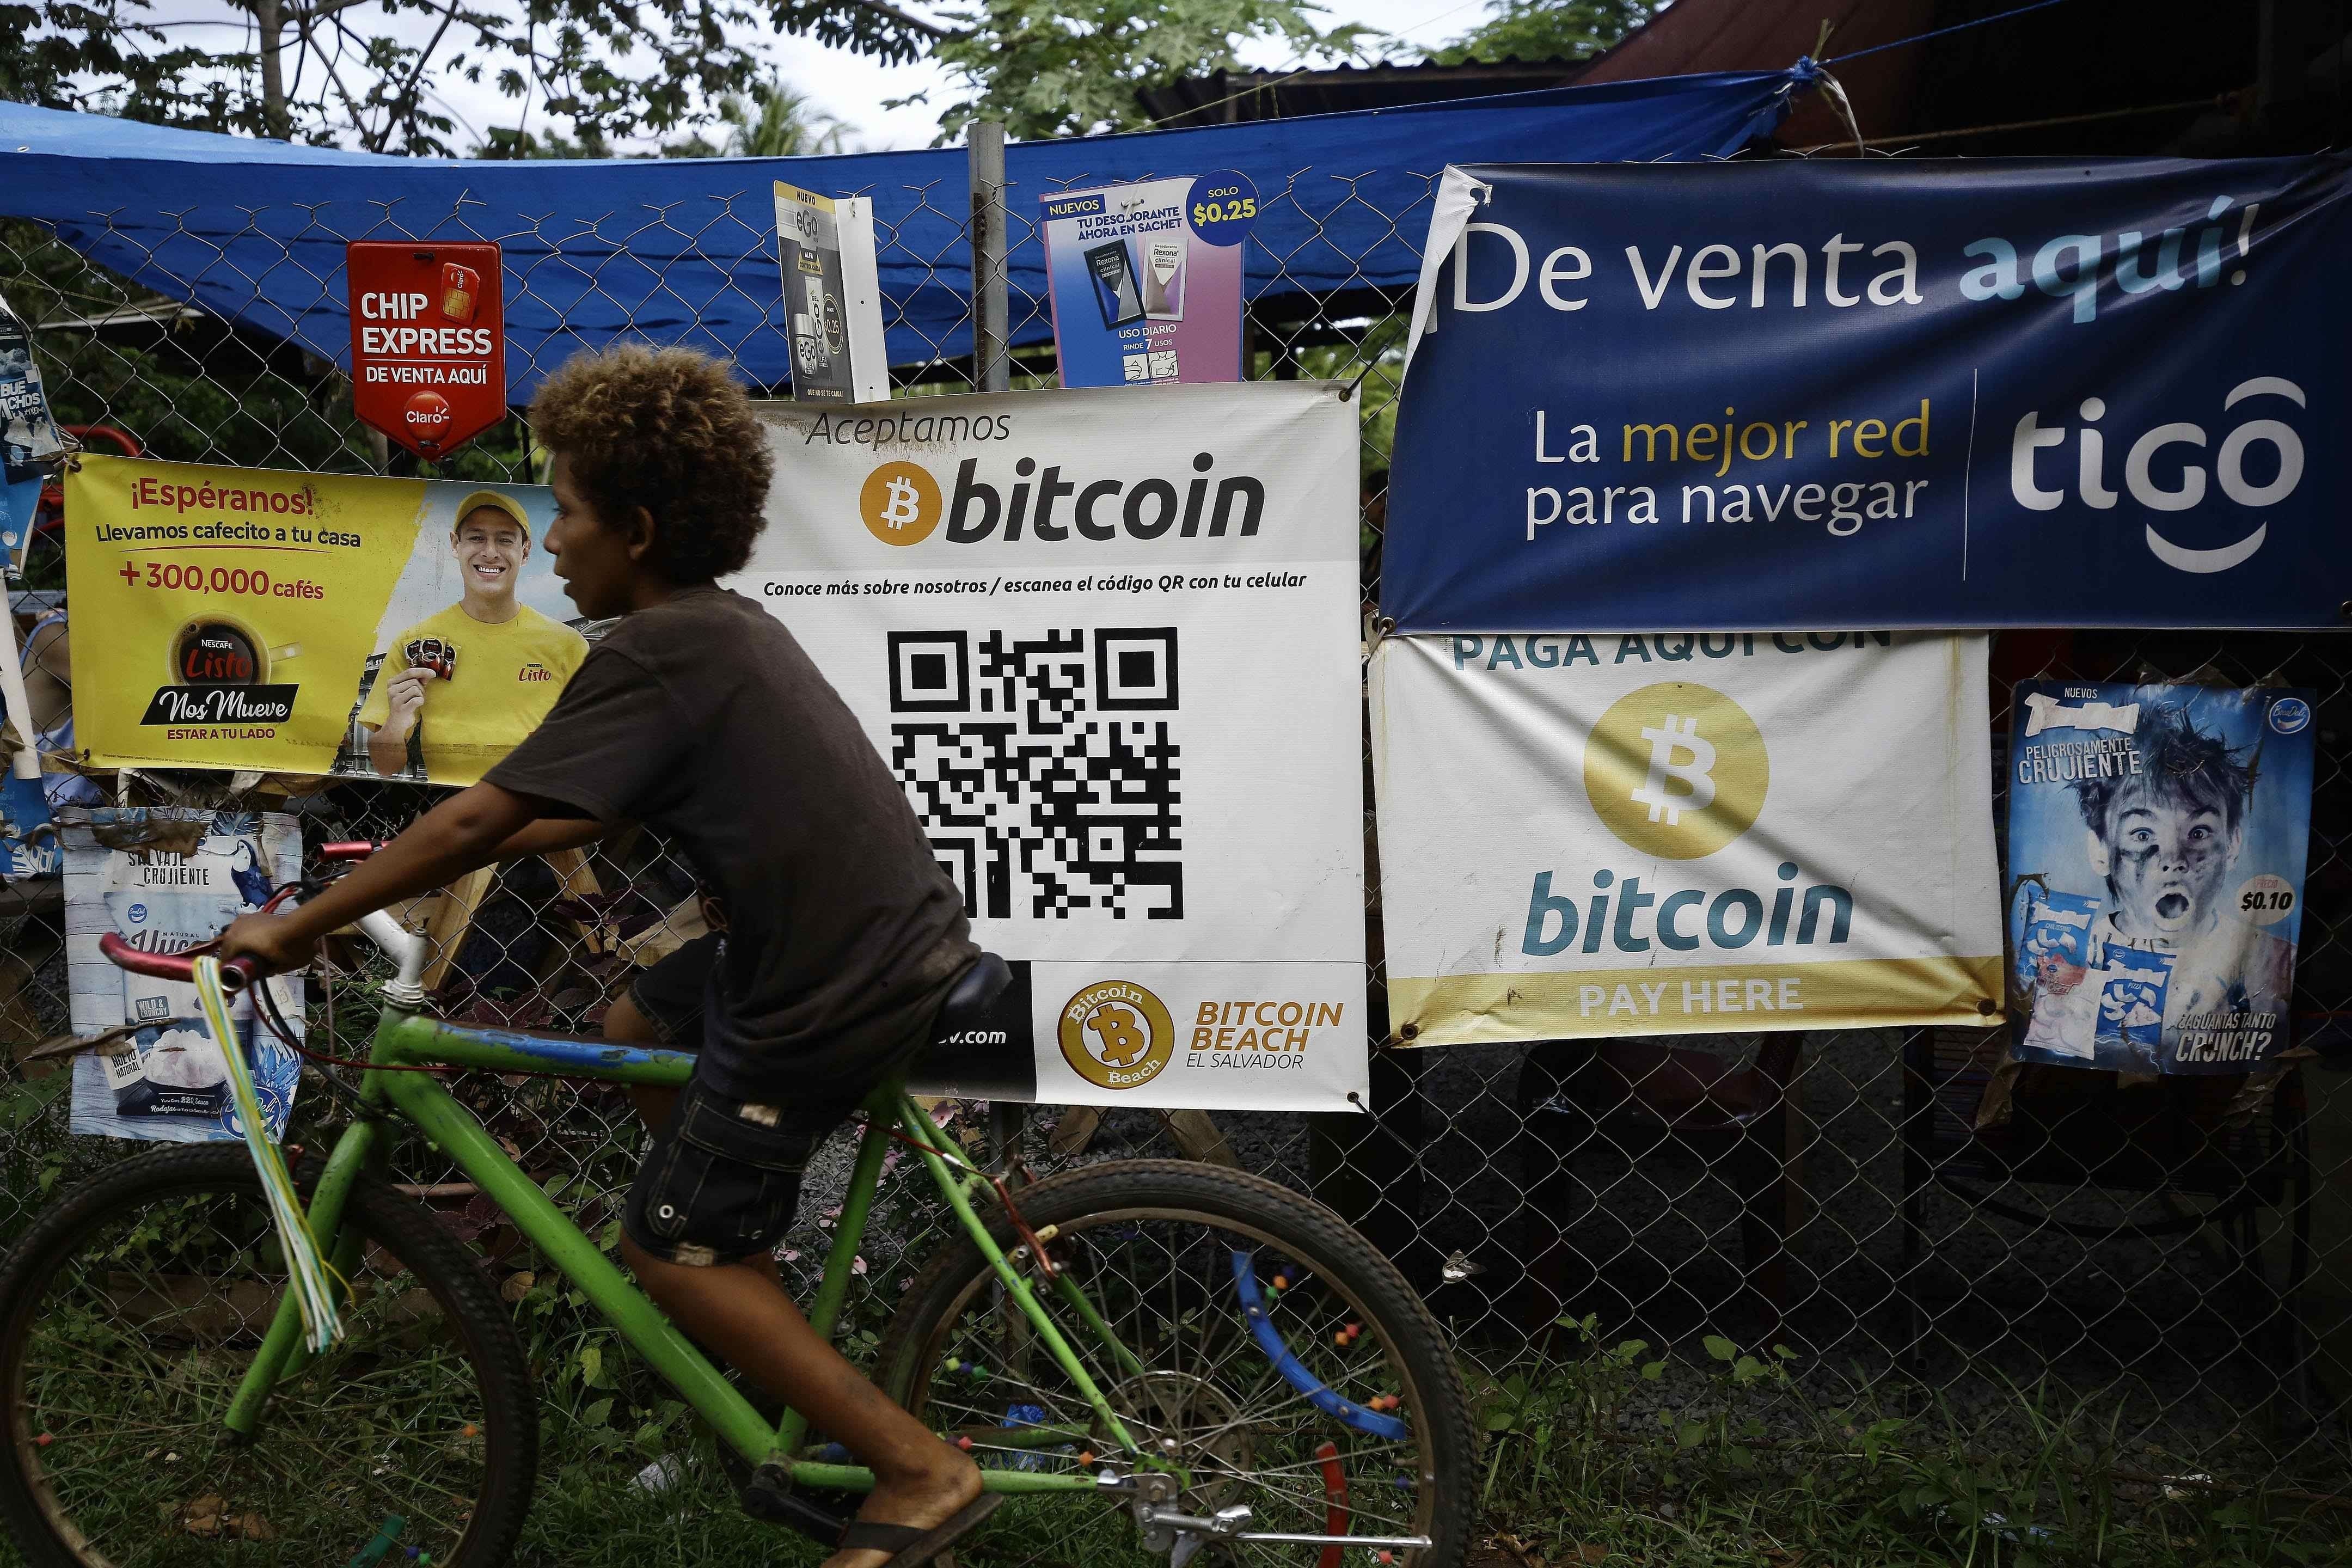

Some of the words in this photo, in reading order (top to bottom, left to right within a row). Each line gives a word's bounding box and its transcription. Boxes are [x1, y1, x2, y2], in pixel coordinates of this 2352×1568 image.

[797, 191, 816, 206] NUEVO
[1208, 186, 1239, 198] SOLO
[1049, 199, 1100, 216] NUEVOS
[1193, 198, 1257, 228] $0.25
[1077, 218, 1093, 229] TU
[1078, 226, 1118, 241] AHORA
[1120, 224, 1136, 235] EN
[1138, 218, 1182, 232] SACHET
[804, 251, 814, 260] ALFA
[1096, 255, 1119, 267] Rexona
[1154, 248, 1178, 257] Rexona
[1625, 232, 1924, 310] venta
[1960, 194, 2260, 323] aquí!
[1100, 262, 1120, 273] clinical
[457, 270, 465, 288] Claro
[362, 292, 428, 319] CHIP
[1119, 328, 1140, 338] USO
[1142, 324, 1177, 336] DIARIO
[363, 327, 492, 355] EXPRESS
[1123, 342, 1144, 351] RINDE
[1145, 338, 1153, 350] 7
[366, 366, 388, 382] DE
[390, 367, 445, 383] VENTA
[448, 364, 487, 384] AQUÍ
[406, 408, 446, 424] Claro
[805, 411, 1011, 451] Aceptamos
[1535, 409, 1600, 463] La
[1622, 407, 1807, 478] mejor
[1830, 398, 1930, 459] red
[131, 477, 313, 516] ¡Espéranos!
[945, 452, 1265, 544] bitcoin
[1526, 484, 1658, 541] para
[1681, 479, 1928, 536] navegar
[95, 522, 188, 542] Llevamos
[193, 521, 270, 540] cafecito
[275, 528, 286, 541] a
[291, 525, 311, 543] tu
[317, 530, 361, 548] casa
[146, 562, 269, 596] 300,000
[273, 580, 324, 600] cafés
[764, 581, 822, 596] Conoce
[826, 579, 859, 595] más
[863, 579, 909, 595] sobre
[914, 579, 987, 595] nosotros
[989, 577, 1002, 596] /
[1004, 579, 1072, 592] escanea
[1077, 575, 1093, 591] el
[1097, 574, 1153, 593] código
[1158, 575, 1184, 593] QR
[1189, 577, 1218, 589] con
[1223, 574, 1241, 589] tu
[1246, 572, 1307, 587] celular
[1453, 634, 1600, 670] PAGA
[186, 649, 251, 679] Listo
[518, 668, 551, 682] Listo
[2065, 687, 2098, 699] NUEVOS
[159, 691, 208, 721] Nos
[206, 690, 287, 720] Mueve
[167, 729, 207, 740] ESTAR
[210, 729, 219, 739] A
[220, 728, 237, 739] TU
[240, 728, 275, 739] LADO
[2026, 738, 2133, 760] PELIGROSAMENTE
[2019, 751, 2143, 784] CRUJIENTE
[144, 867, 210, 885] CRUJIENTE
[1522, 861, 1853, 956] bitcoin
[2241, 892, 2293, 911] $0.10
[131, 929, 200, 954] Yuc
[137, 999, 156, 1011] WILD
[158, 999, 163, 1007] &
[1578, 982, 1669, 1018] PAY
[1682, 977, 1803, 1013] HERE
[140, 1007, 168, 1018] CRUNCHY
[1195, 1001, 1344, 1027] BITCOIN
[2241, 1011, 2276, 1028] TANTO
[939, 1031, 1006, 1044] v.com
[1190, 1027, 1310, 1052] BEACH
[2176, 1031, 2272, 1062] CRUNCH?
[111, 1049, 137, 1068] NUEVO
[1186, 1054, 1206, 1068] EL
[1209, 1054, 1304, 1070] SALVADOR
[115, 1062, 142, 1079] NATURAL
[150, 1105, 176, 1113] Rodajas
